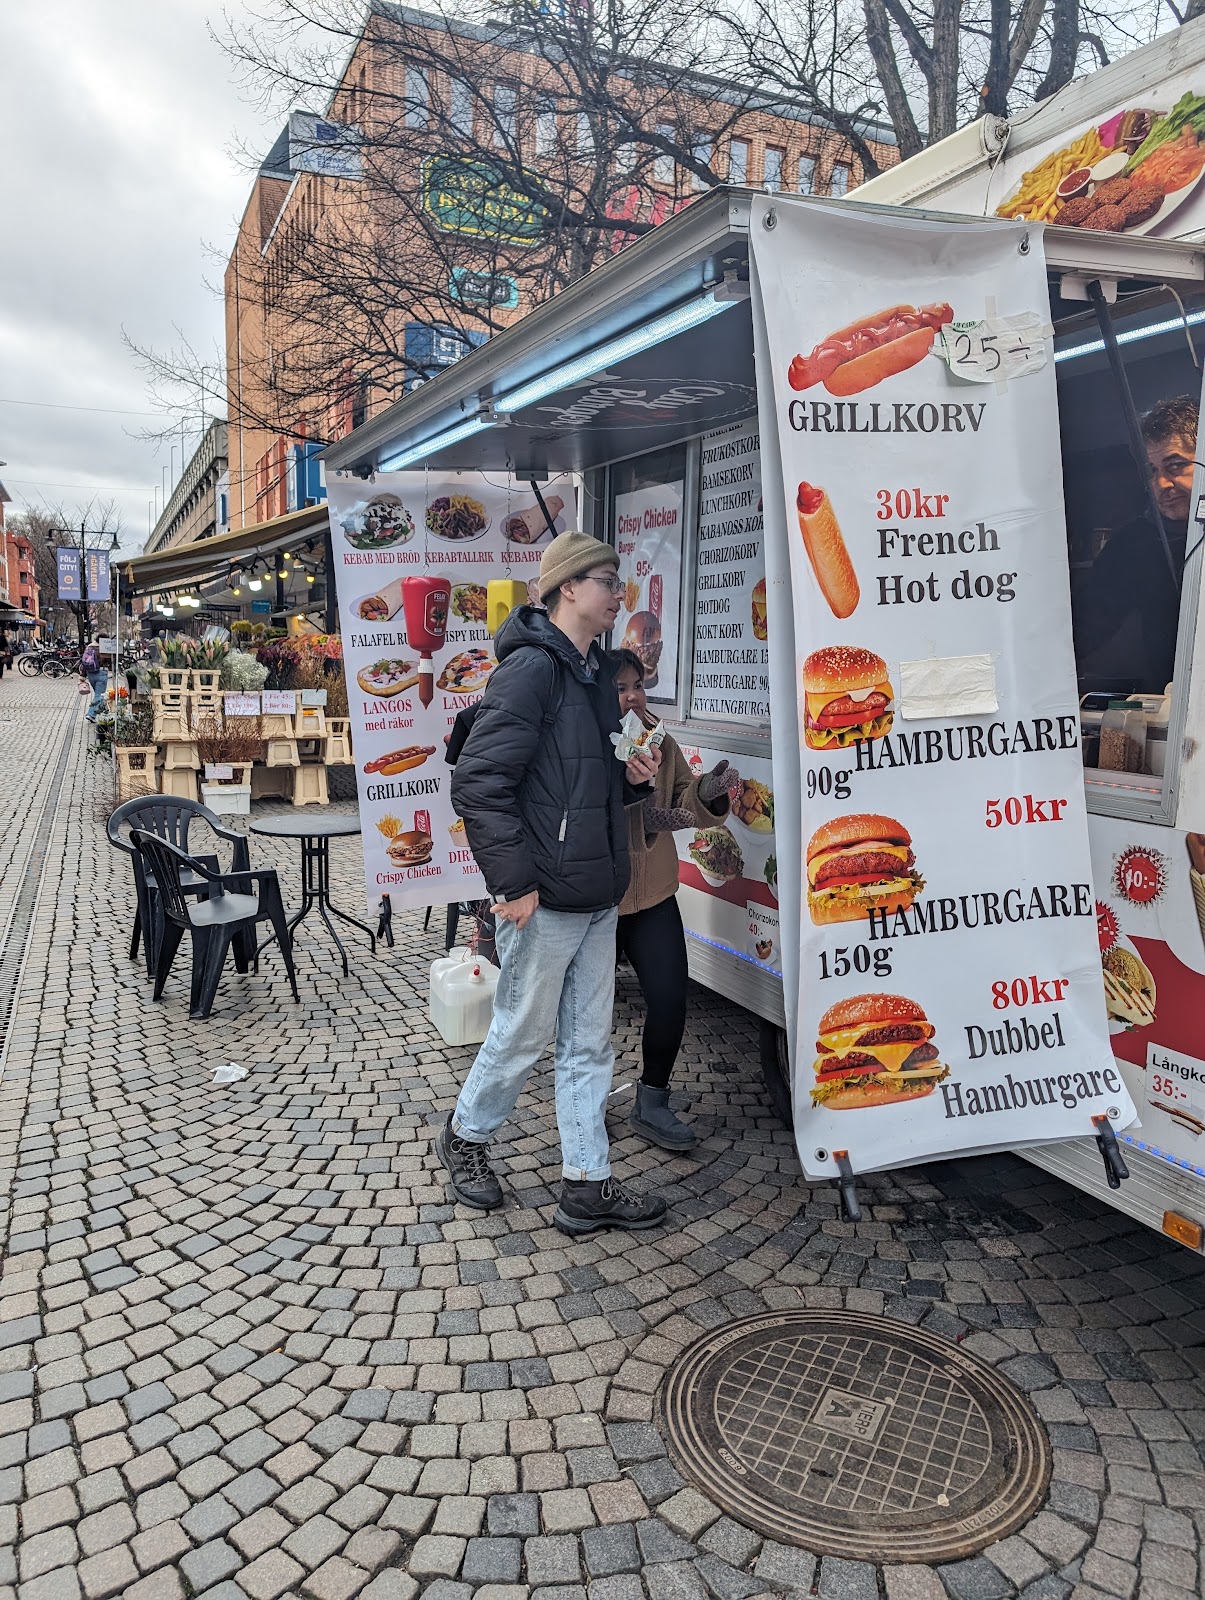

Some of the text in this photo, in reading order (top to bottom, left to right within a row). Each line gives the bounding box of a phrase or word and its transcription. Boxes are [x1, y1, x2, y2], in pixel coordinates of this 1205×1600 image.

[788, 400, 986, 433] GRILLKORV
[702, 463, 754, 490] BAMSEKORV
[701, 490, 754, 515] LUNCHKORV
[876, 488, 949, 519] 30kr
[618, 506, 677, 536] Crispy Chicken
[700, 517, 744, 541] KABANOSS
[877, 523, 1000, 558] French
[60, 554, 77, 563] FÖLJ
[343, 549, 420, 565] KEBAB MED BRÖD
[424, 551, 495, 563] KEBABTALLRIK
[699, 541, 760, 566] CHORIZOKORV
[60, 564, 77, 572] CITY!
[698, 570, 746, 591] GRILLKORV
[877, 570, 1018, 606] Hot dog
[697, 598, 731, 615] HOTDOG
[351, 633, 395, 648] FALAFEL
[697, 622, 744, 640] KOKT KORV
[696, 649, 757, 664] HAMBURGARE
[695, 674, 757, 690] HAMBURGARE
[363, 699, 412, 715] LANGOS
[365, 716, 414, 731] med räkor
[854, 715, 1079, 772] HAMBURGARE
[366, 777, 441, 802] GRILLKORV
[806, 766, 853, 800] 90g
[985, 795, 1068, 828] 50kr
[376, 864, 442, 885] Crispy Chicken
[866, 884, 1093, 940] HAMBURGARE
[748, 923, 763, 937] 40:-
[818, 943, 893, 980] 150g
[991, 975, 1069, 1010] 80kr
[964, 1013, 1066, 1060] Dubbel
[939, 1066, 1122, 1119] Hamburgare
[1152, 1074, 1187, 1099] 35:-
[826, 1398, 850, 1418] A
[856, 1403, 877, 1437] TIERP
[720, 1450, 742, 1471] 2009
